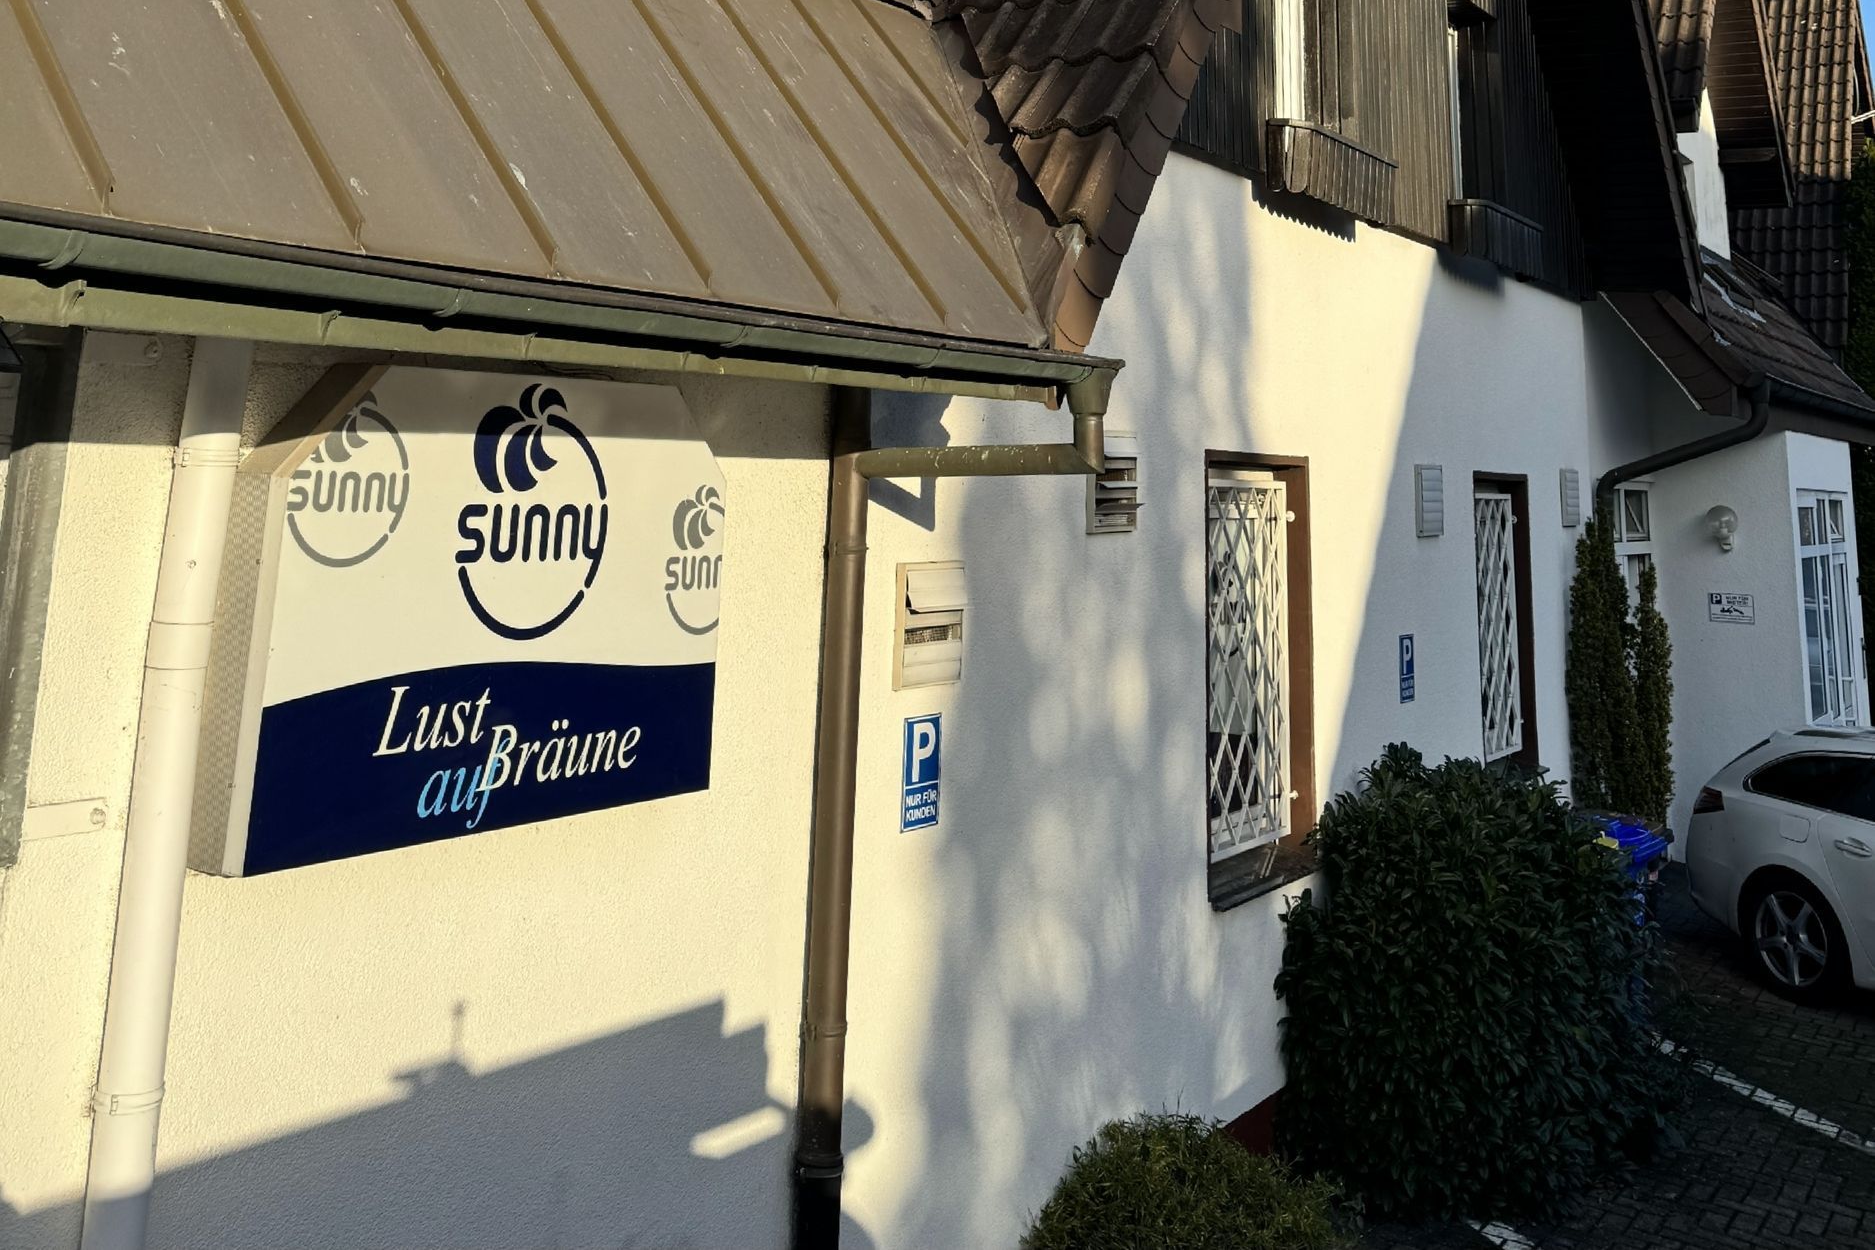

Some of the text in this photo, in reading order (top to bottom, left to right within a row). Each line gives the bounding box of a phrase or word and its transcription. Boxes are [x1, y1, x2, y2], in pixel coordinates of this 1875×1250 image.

[455, 503, 608, 589] sunny
[1403, 638, 1412, 675] P
[372, 686, 491, 757] Lust
[911, 721, 936, 783] P
[416, 718, 641, 829] auf Bräune
[905, 789, 937, 808] NUR FÜR
[906, 805, 936, 821] KUNDEN
